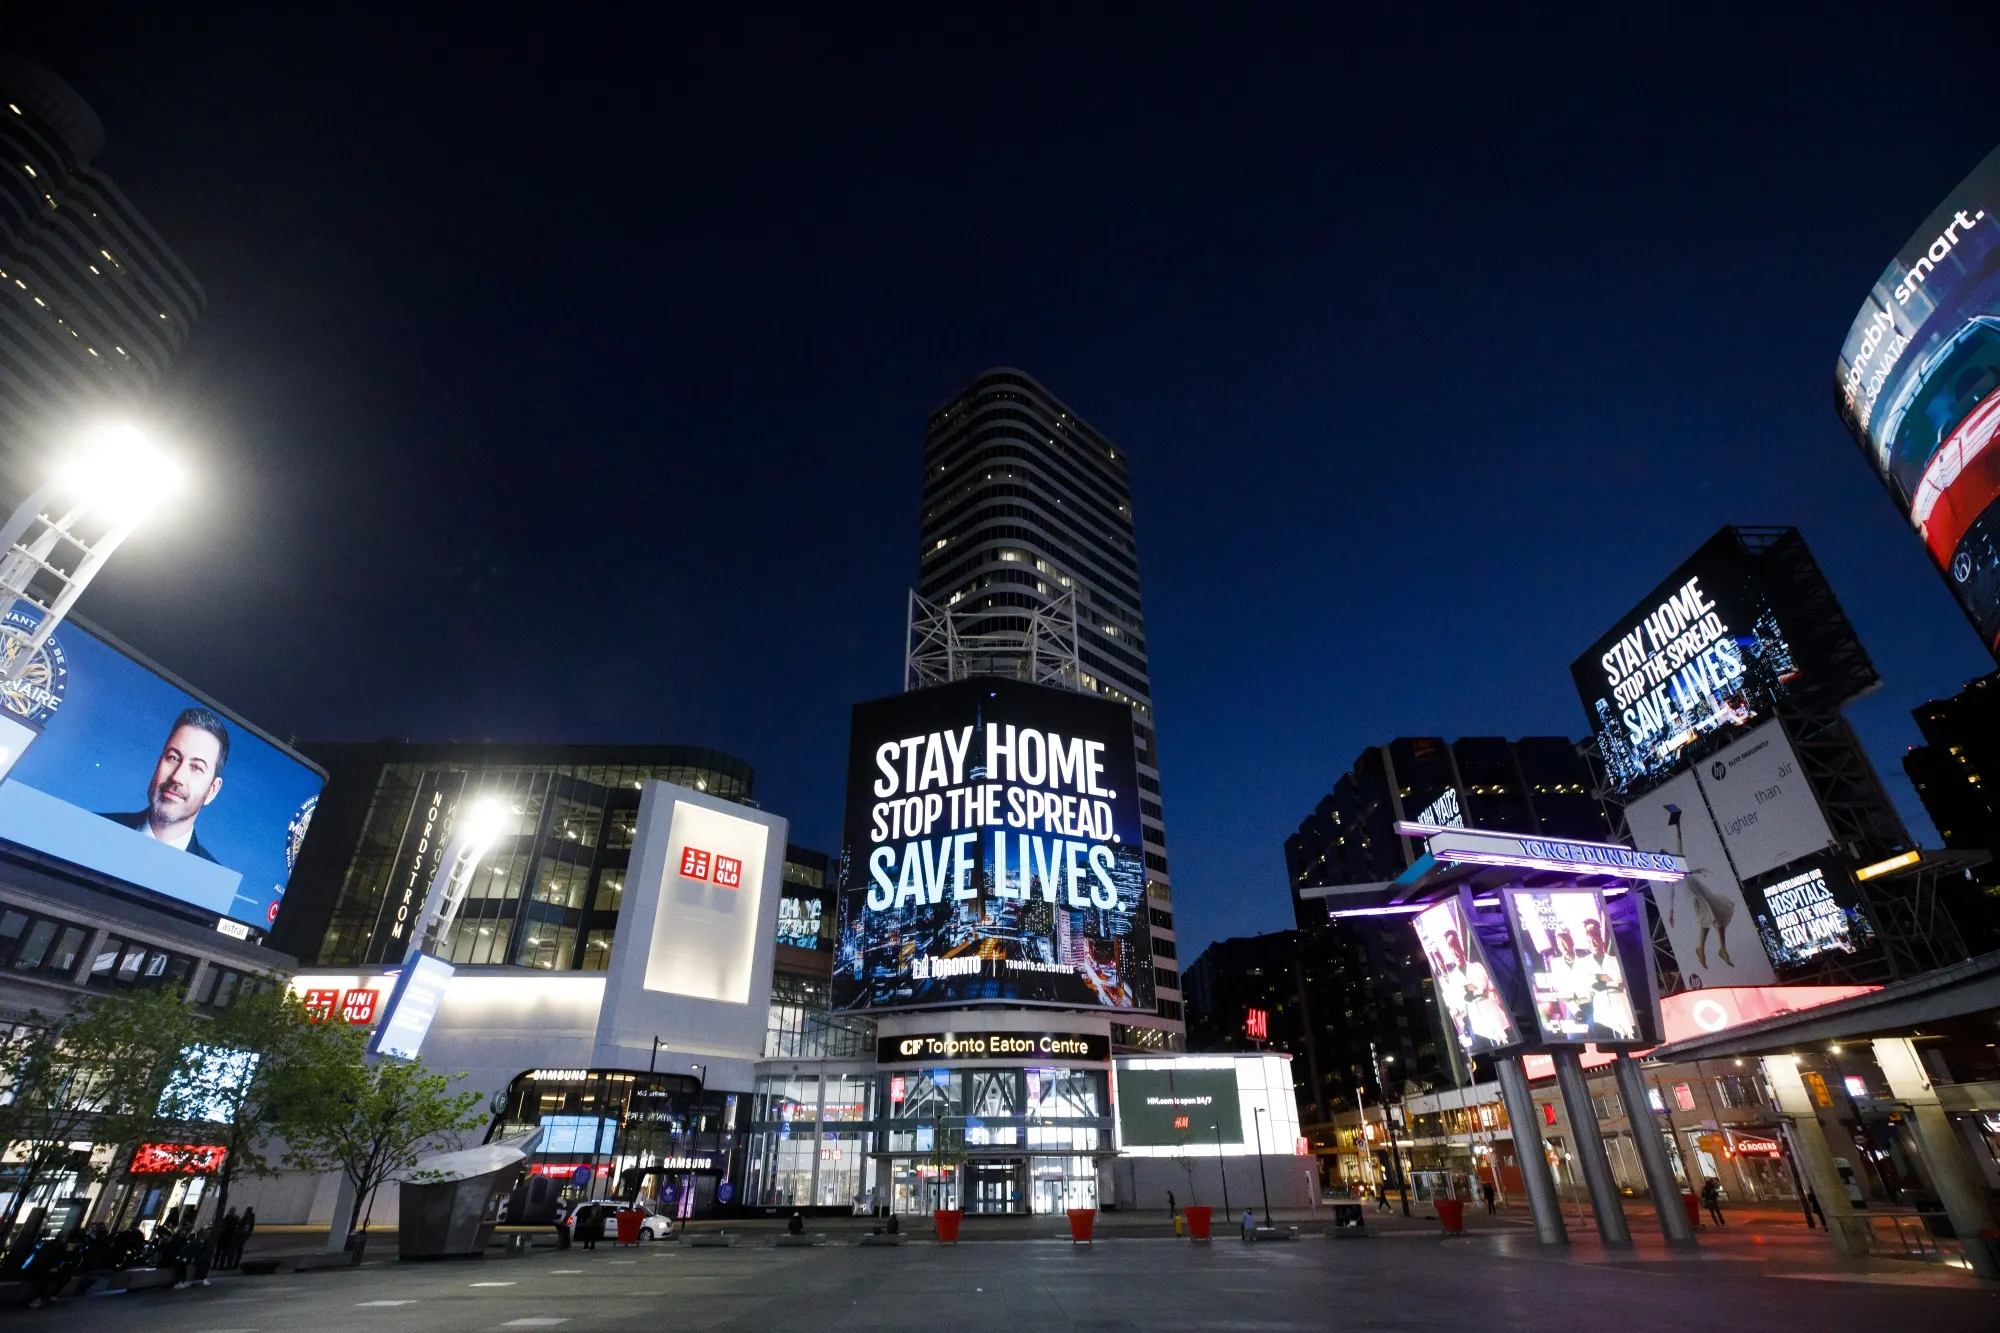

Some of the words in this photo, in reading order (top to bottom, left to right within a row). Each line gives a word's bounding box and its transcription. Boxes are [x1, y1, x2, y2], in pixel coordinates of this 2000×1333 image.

[1841, 301, 1896, 425] shionably
[1894, 209, 1985, 306] smart.
[1866, 333, 1914, 402] SONATA.
[1602, 625, 1648, 687] STAY
[1643, 576, 1716, 651] HOME.
[54, 648, 65, 664] BE
[1613, 670, 1645, 710] STOP
[1642, 651, 1672, 688] THE
[1666, 612, 1729, 670] SPREAD.
[59, 667, 67, 677] A
[1623, 683, 1679, 745] SAVE
[1670, 638, 1748, 712] LIVES.
[874, 725, 974, 798] STAY
[986, 722, 1117, 799] HOME.
[1728, 755, 1741, 767] ELITE
[1777, 762, 1793, 778] air
[1754, 784, 1782, 804] than
[871, 793, 943, 843] STOP
[946, 784, 1003, 830] THE
[1007, 786, 1121, 843] SPREAD.
[1723, 811, 1758, 836] Lighter
[391, 791, 443, 939] NORDSTROM
[718, 858, 738, 872] UNI
[867, 831, 977, 912] SAVE
[994, 830, 1126, 912] LIVES.
[1652, 853, 1679, 872] SQ
[716, 870, 738, 884] QLO
[1809, 868, 1824, 880] OUR
[1767, 879, 1834, 917] HOSPITALS.
[1775, 913, 1800, 930] AVOID
[1796, 906, 1814, 922] THE
[1810, 898, 1840, 917] VIRUS.
[221, 923, 245, 936] astral
[1780, 924, 1810, 948] STAY
[1806, 912, 1849, 940] HOME.
[347, 992, 373, 1006] UNI
[342, 1006, 370, 1022] QLO
[900, 1039, 924, 1056] CF
[925, 1038, 985, 1054] Toronto
[990, 1036, 1035, 1052] Eaton
[1039, 1036, 1088, 1055] Centre
[533, 1070, 586, 1081] SAMSUNG
[1180, 1098, 1197, 1106] open
[1747, 1142, 1777, 1151] ROGERS
[663, 1157, 712, 1169] SAMSUNG
